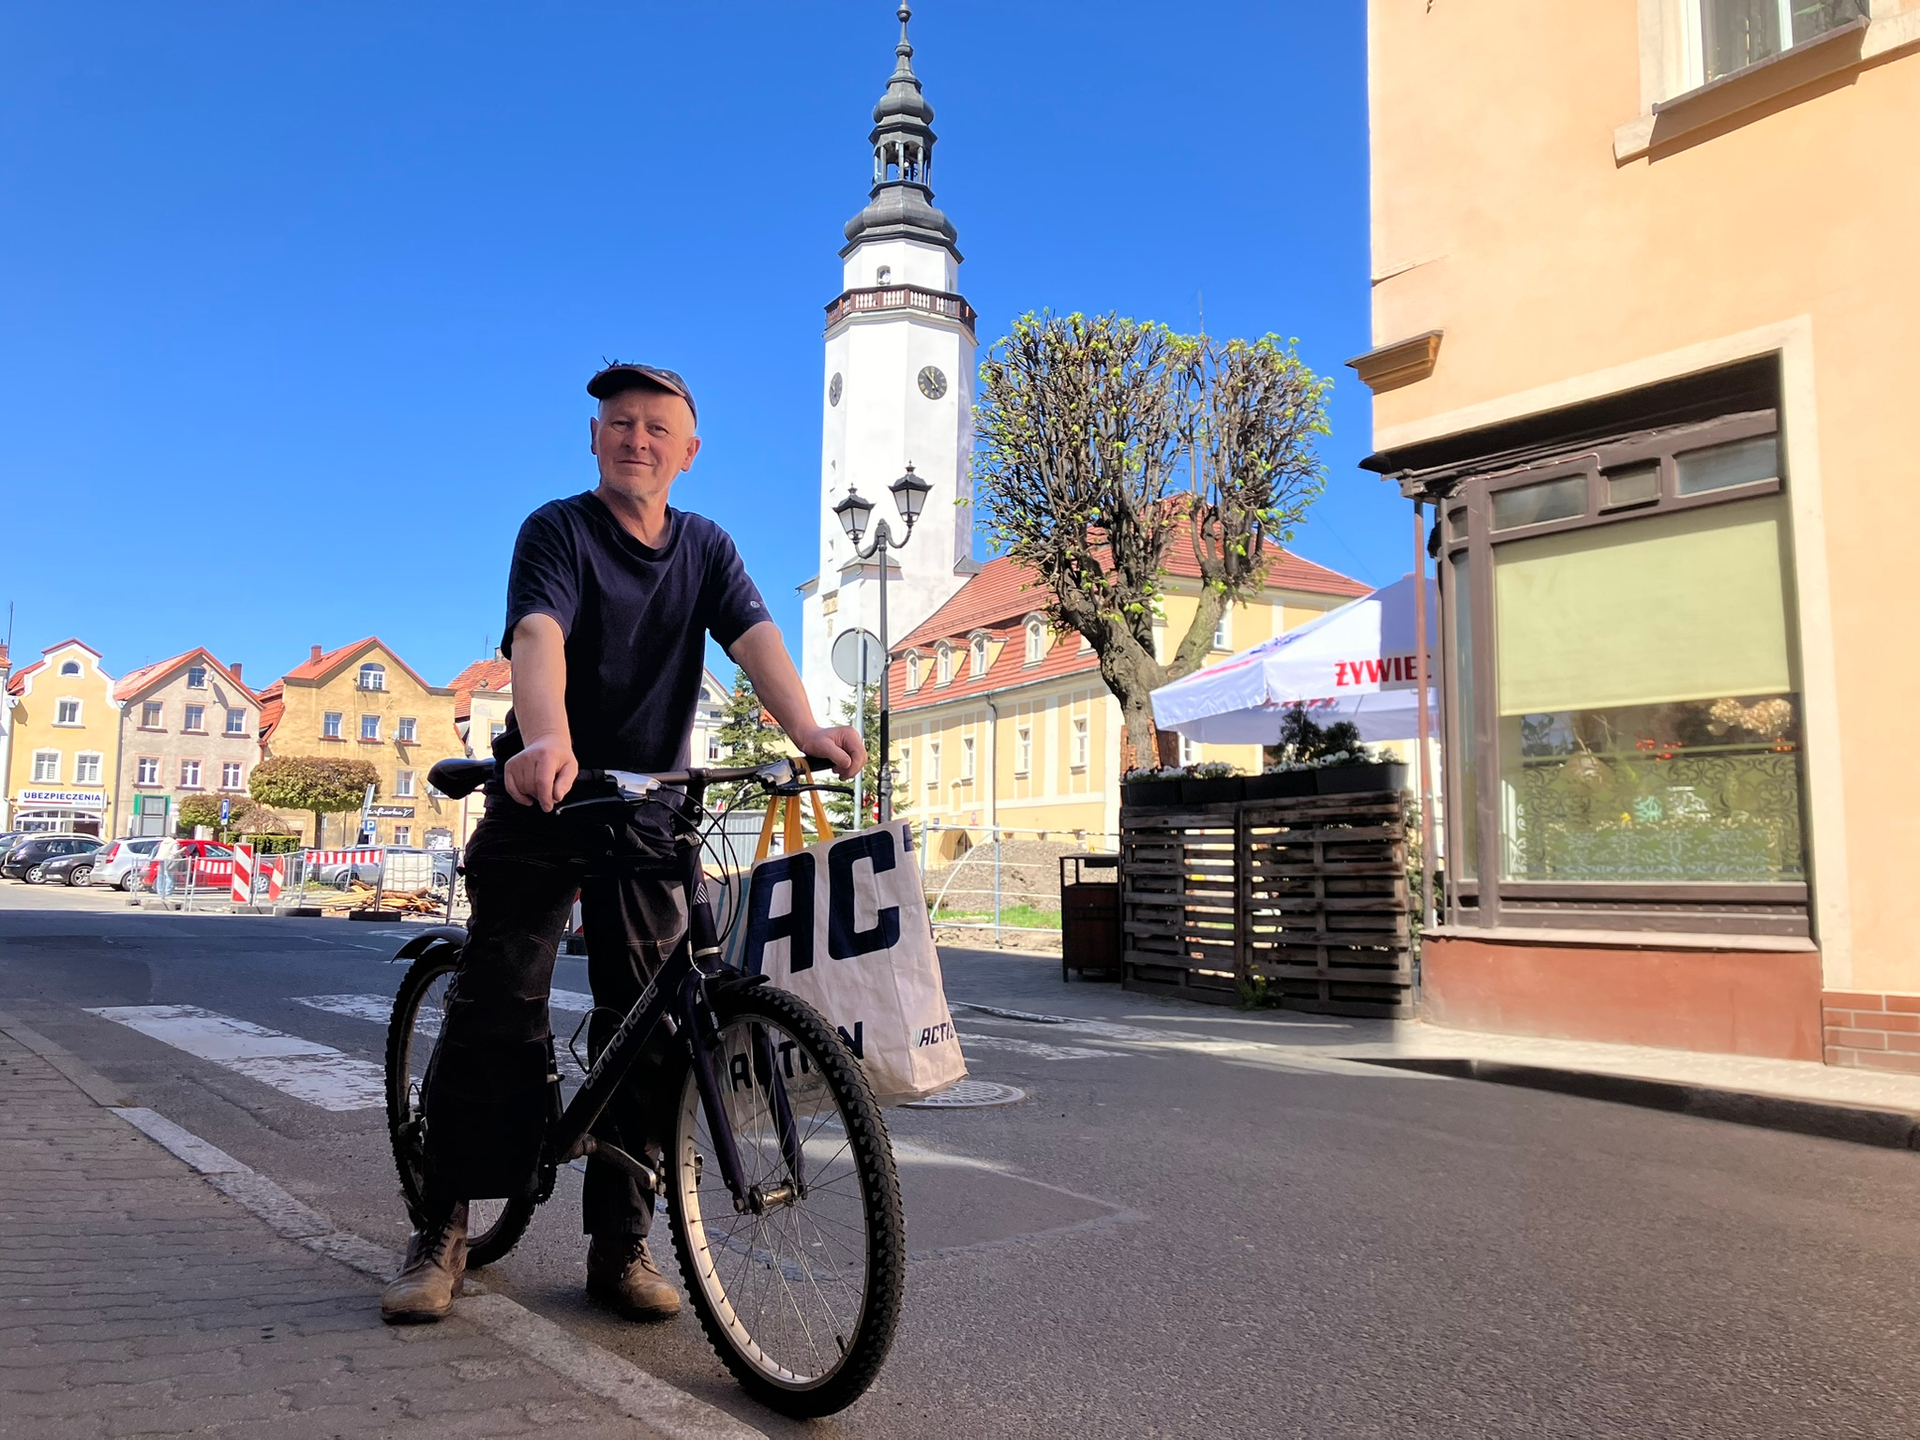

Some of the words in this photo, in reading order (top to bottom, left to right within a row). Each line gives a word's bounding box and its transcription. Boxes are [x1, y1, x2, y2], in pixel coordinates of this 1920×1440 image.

[24, 792, 101, 801] UBEZPIECZENIA
[367, 821, 375, 831] P
[746, 824, 914, 975] AC
[584, 980, 659, 1090] cannondale
